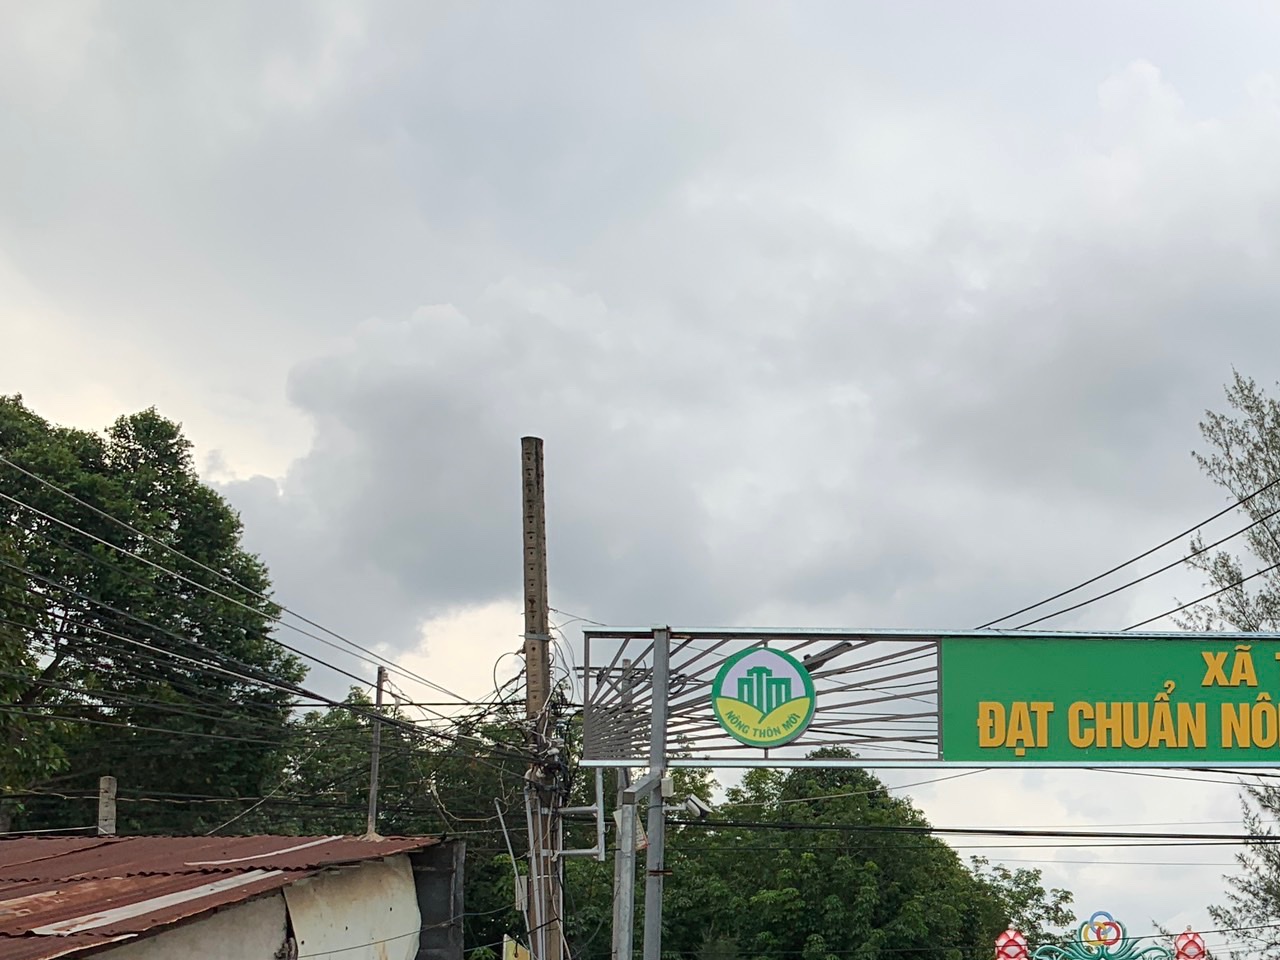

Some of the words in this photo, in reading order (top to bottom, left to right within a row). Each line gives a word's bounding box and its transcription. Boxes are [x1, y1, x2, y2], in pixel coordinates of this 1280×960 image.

[1201, 643, 1258, 687] XÃ
[725, 710, 750, 734] NÔNG
[752, 726, 782, 738] THÔN
[781, 712, 801, 731] MỚI
[977, 701, 1054, 756] ĐẠT
[1068, 680, 1206, 748] CHUẨN
